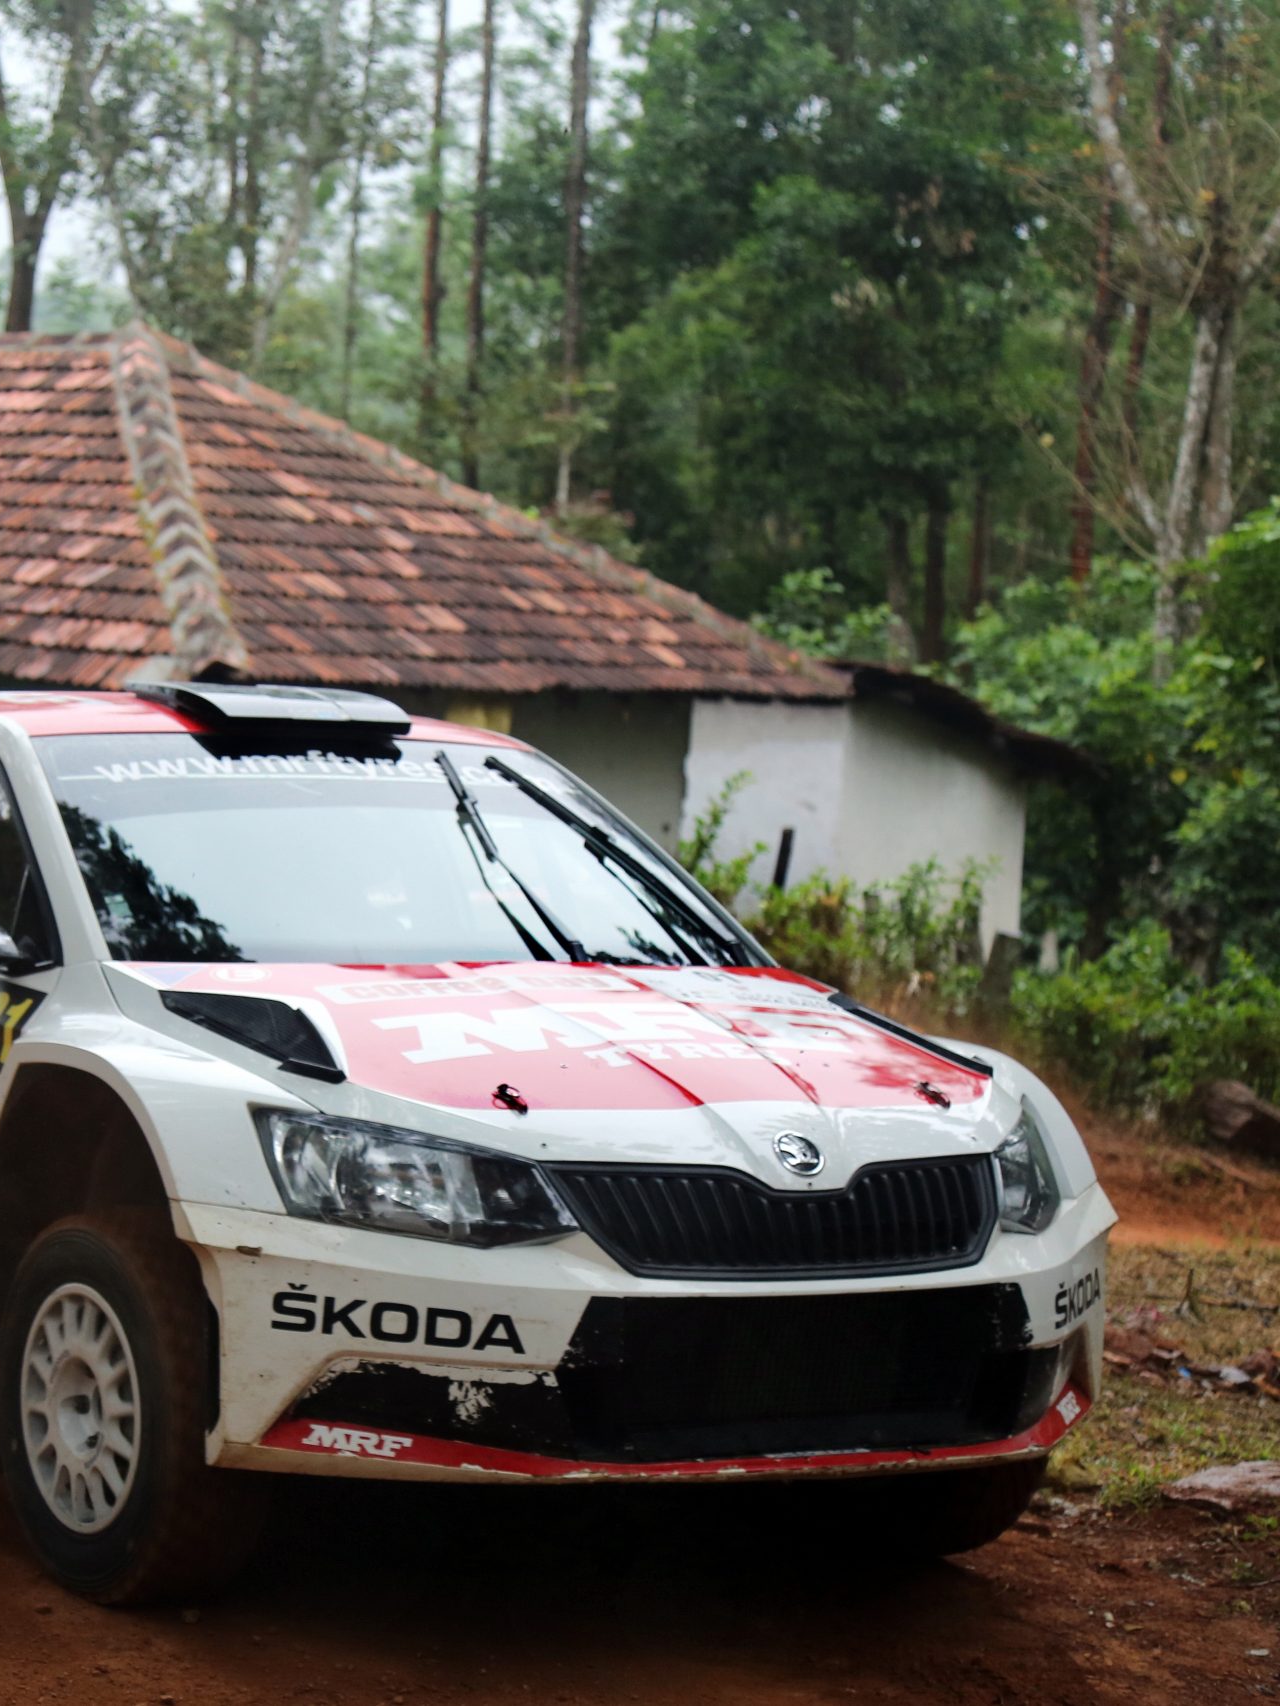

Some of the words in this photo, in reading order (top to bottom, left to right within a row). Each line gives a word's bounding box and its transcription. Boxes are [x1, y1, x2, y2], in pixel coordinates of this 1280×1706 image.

[271, 1283, 525, 1354] ŠKODA
[1055, 1268, 1101, 1331] ŠKODA
[301, 1424, 413, 1458] MRF
